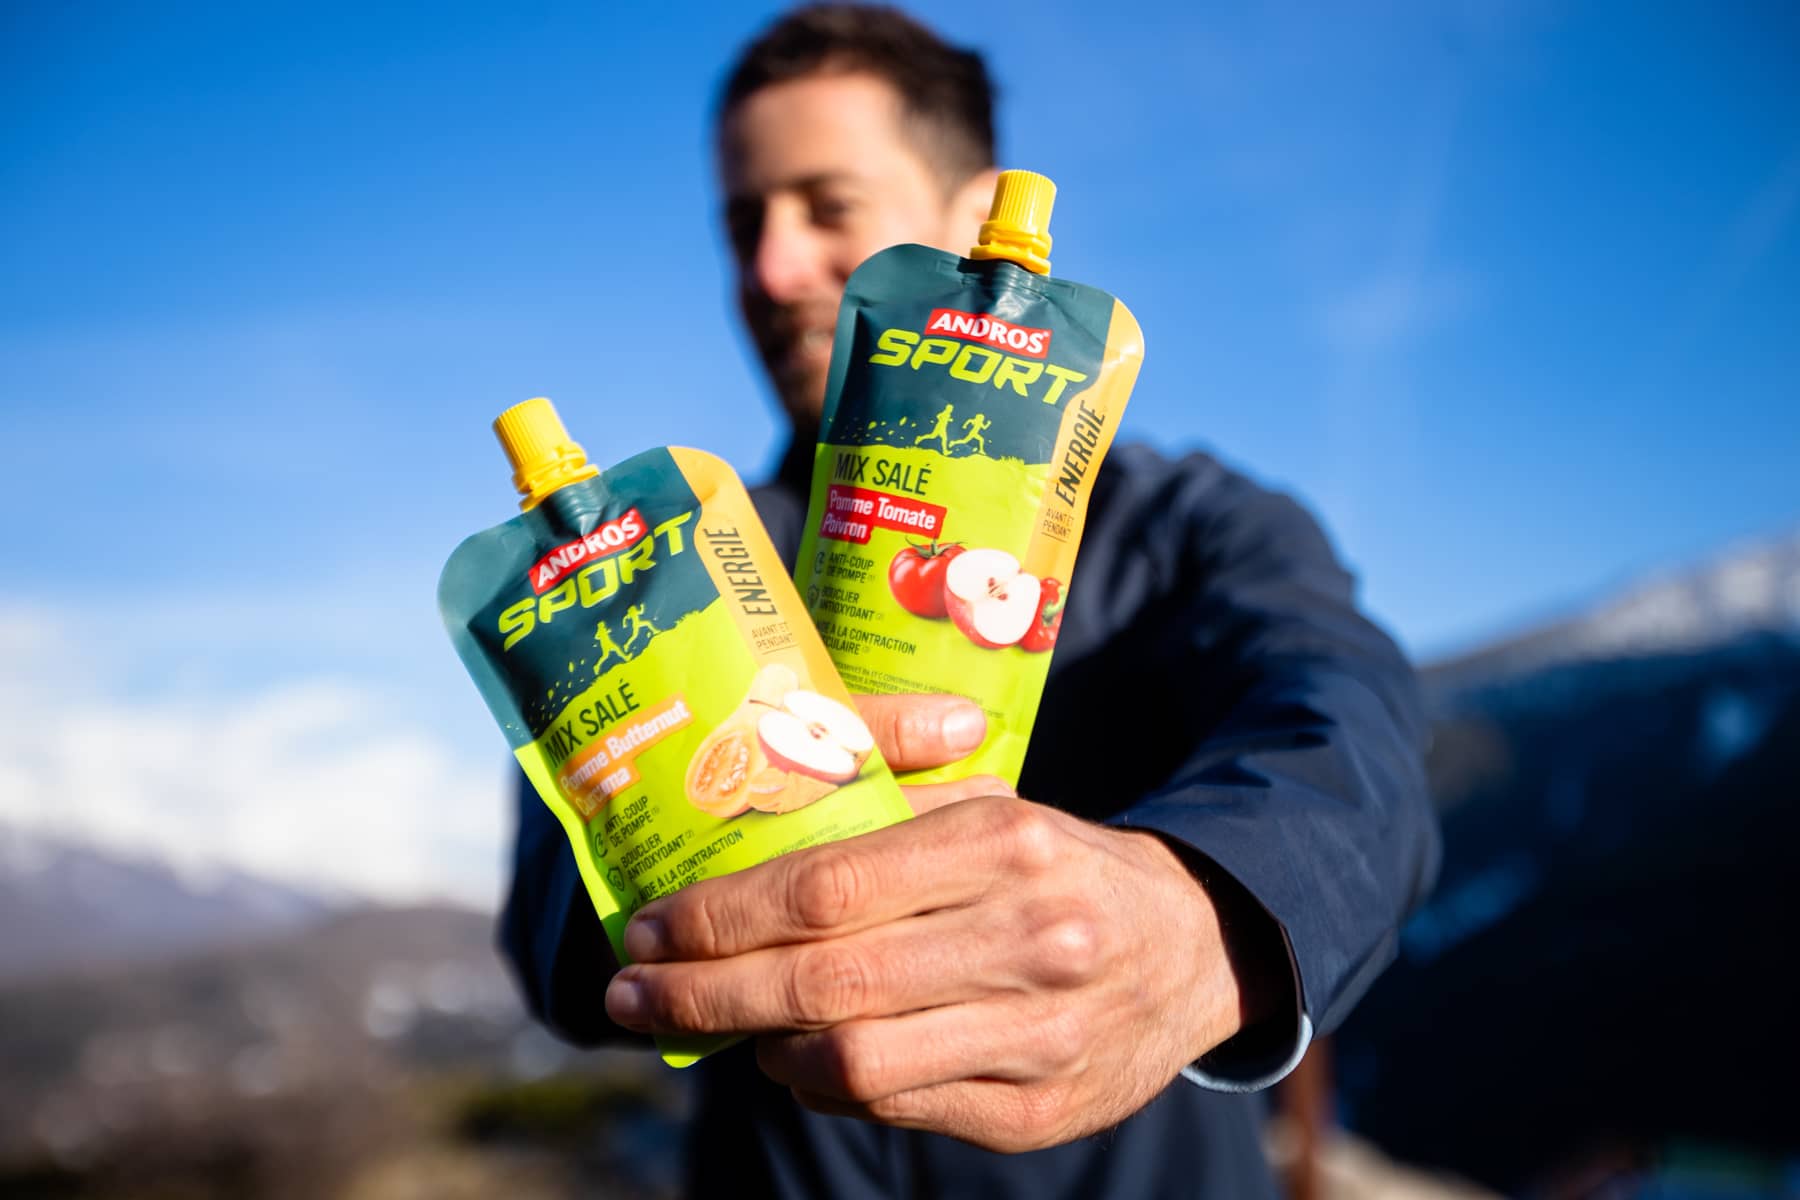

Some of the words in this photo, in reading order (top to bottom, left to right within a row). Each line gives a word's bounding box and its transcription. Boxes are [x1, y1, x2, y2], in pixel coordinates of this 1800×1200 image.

[931, 312, 1044, 354] ANDROS
[869, 328, 1087, 405] SPORT
[834, 453, 869, 482] MIX
[872, 459, 932, 495] SALÉ
[1055, 399, 1105, 508] ENERGIE
[823, 513, 867, 539] Poivron
[829, 489, 873, 515] Pomme
[877, 496, 936, 530] Tomate
[537, 513, 643, 589] ANDROS
[702, 527, 778, 615] ENERGIE
[829, 552, 874, 571] ANTI-COUP
[498, 511, 693, 652] SPORT
[837, 566, 867, 584] POMPE
[751, 624, 777, 640] AVANT
[849, 627, 917, 655] CONTRACTION
[545, 720, 582, 768] MIX
[579, 678, 640, 736] SALÉ
[560, 751, 609, 796] Pomme
[606, 700, 691, 759] Butternut
[605, 796, 649, 834] ANTI-COUP
[609, 830, 623, 848] DE
[621, 810, 654, 839] POMPE
[620, 833, 663, 868] BOUCLIER
[627, 833, 687, 881] ANTIOXYDANT
[664, 869, 678, 885] LA
[677, 828, 744, 875] CONTRACTION
